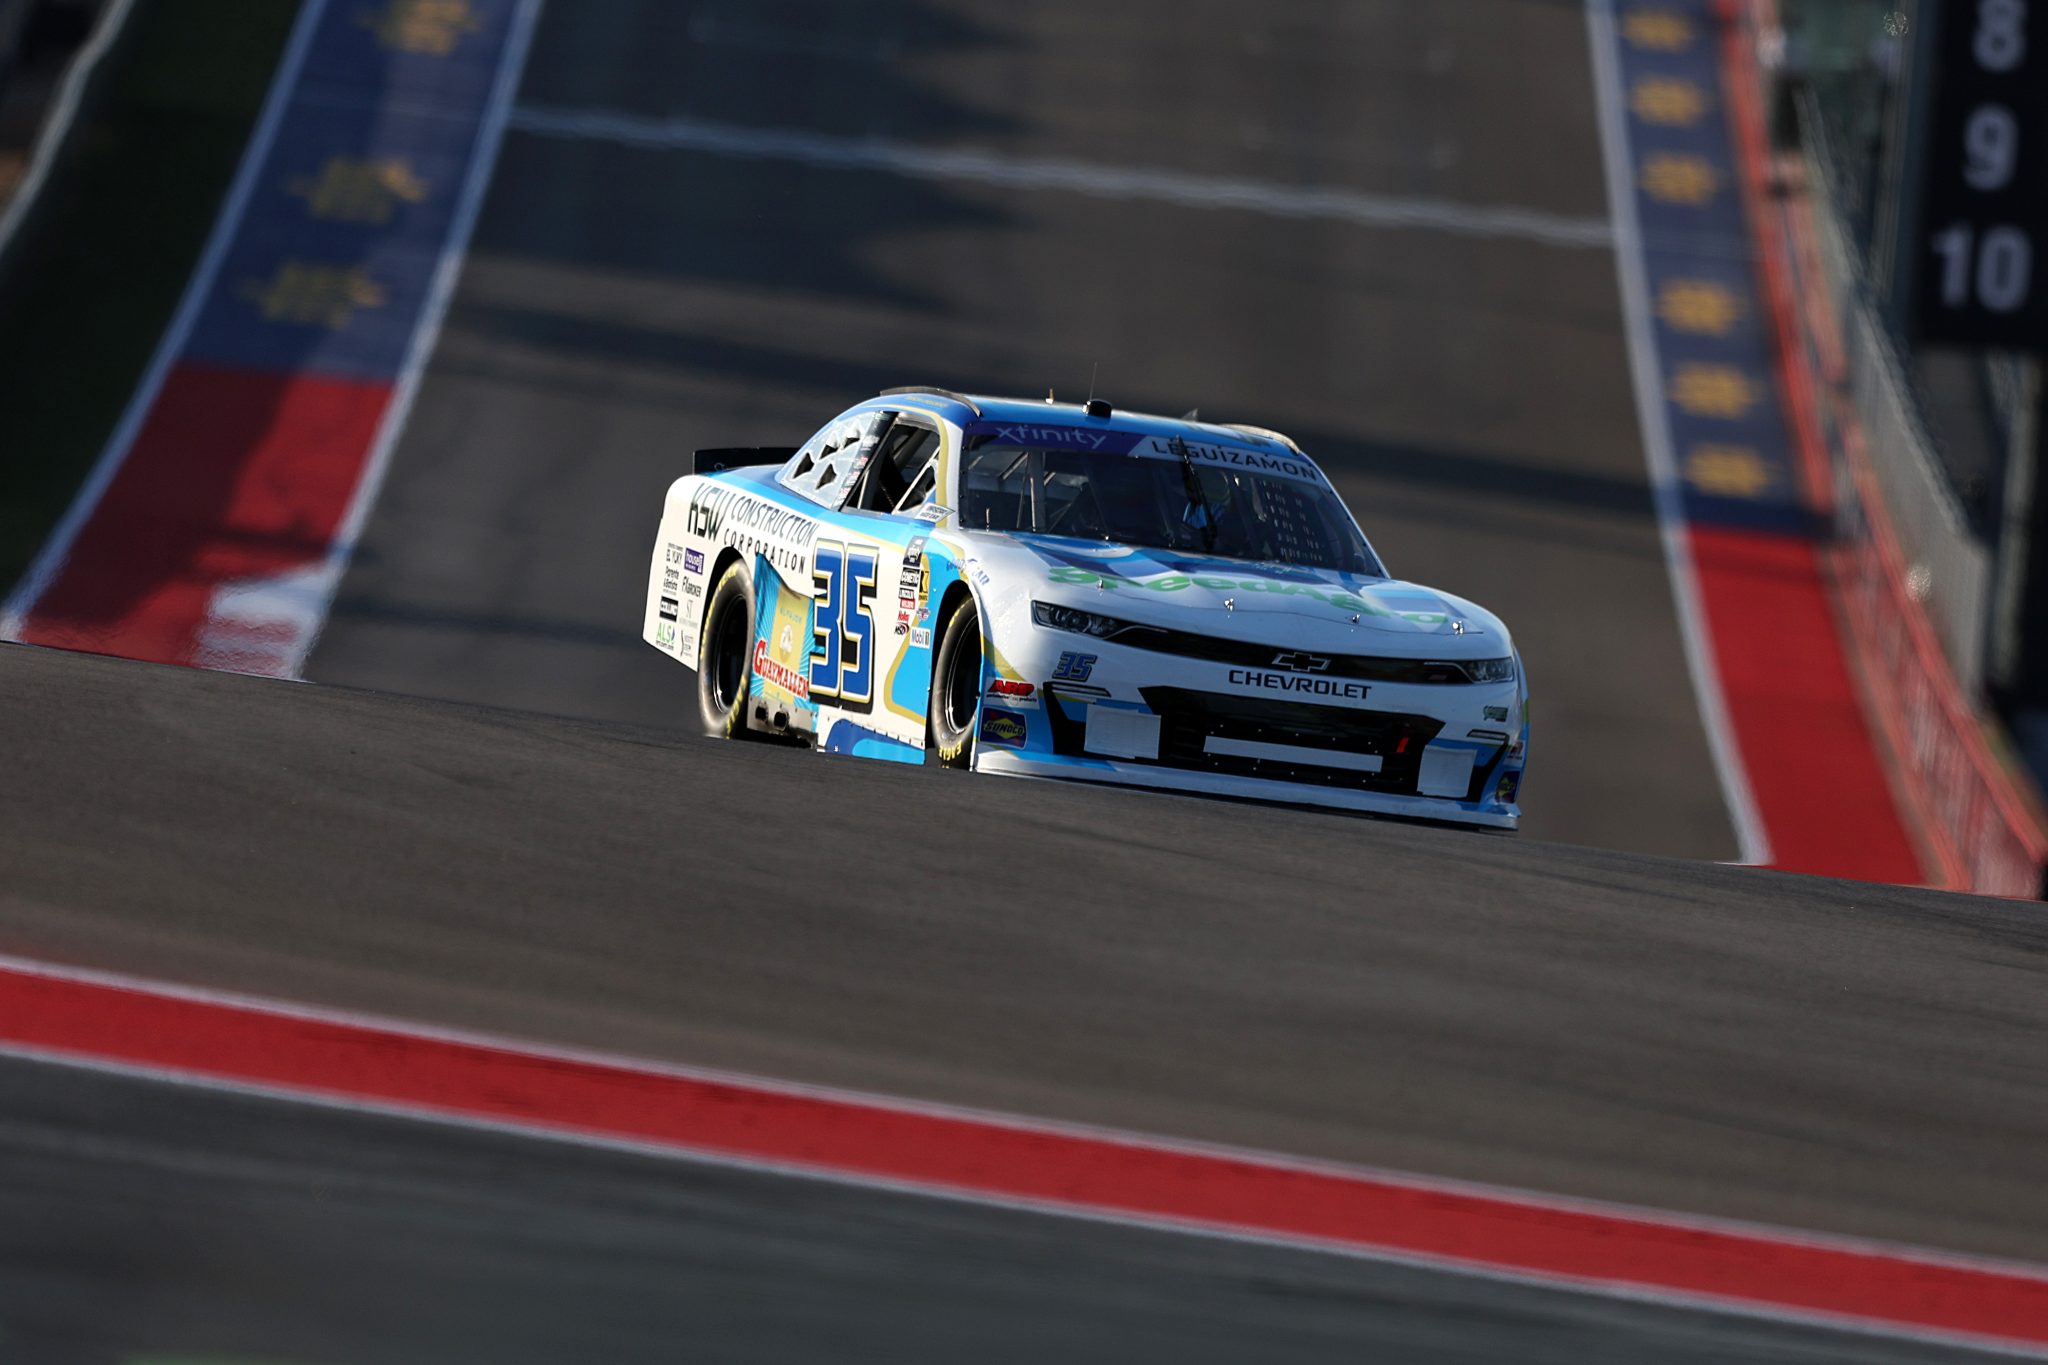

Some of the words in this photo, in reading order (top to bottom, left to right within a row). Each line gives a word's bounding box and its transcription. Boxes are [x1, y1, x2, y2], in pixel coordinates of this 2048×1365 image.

[1972, 0, 2027, 73] 8
[1964, 105, 2019, 192] 9
[1931, 223, 2034, 313] 10
[996, 424, 1107, 449] xfinity
[1152, 440, 1318, 481] LEGUIZAMON
[731, 496, 820, 548] CONSTRUCTION
[724, 528, 806, 575] CORPORATION
[809, 538, 879, 714] 35
[988, 679, 1035, 697] ARP
[1052, 651, 1098, 683] 35
[1228, 670, 1372, 699] CHEVROLET
[984, 720, 1025, 737] SUNOCO
